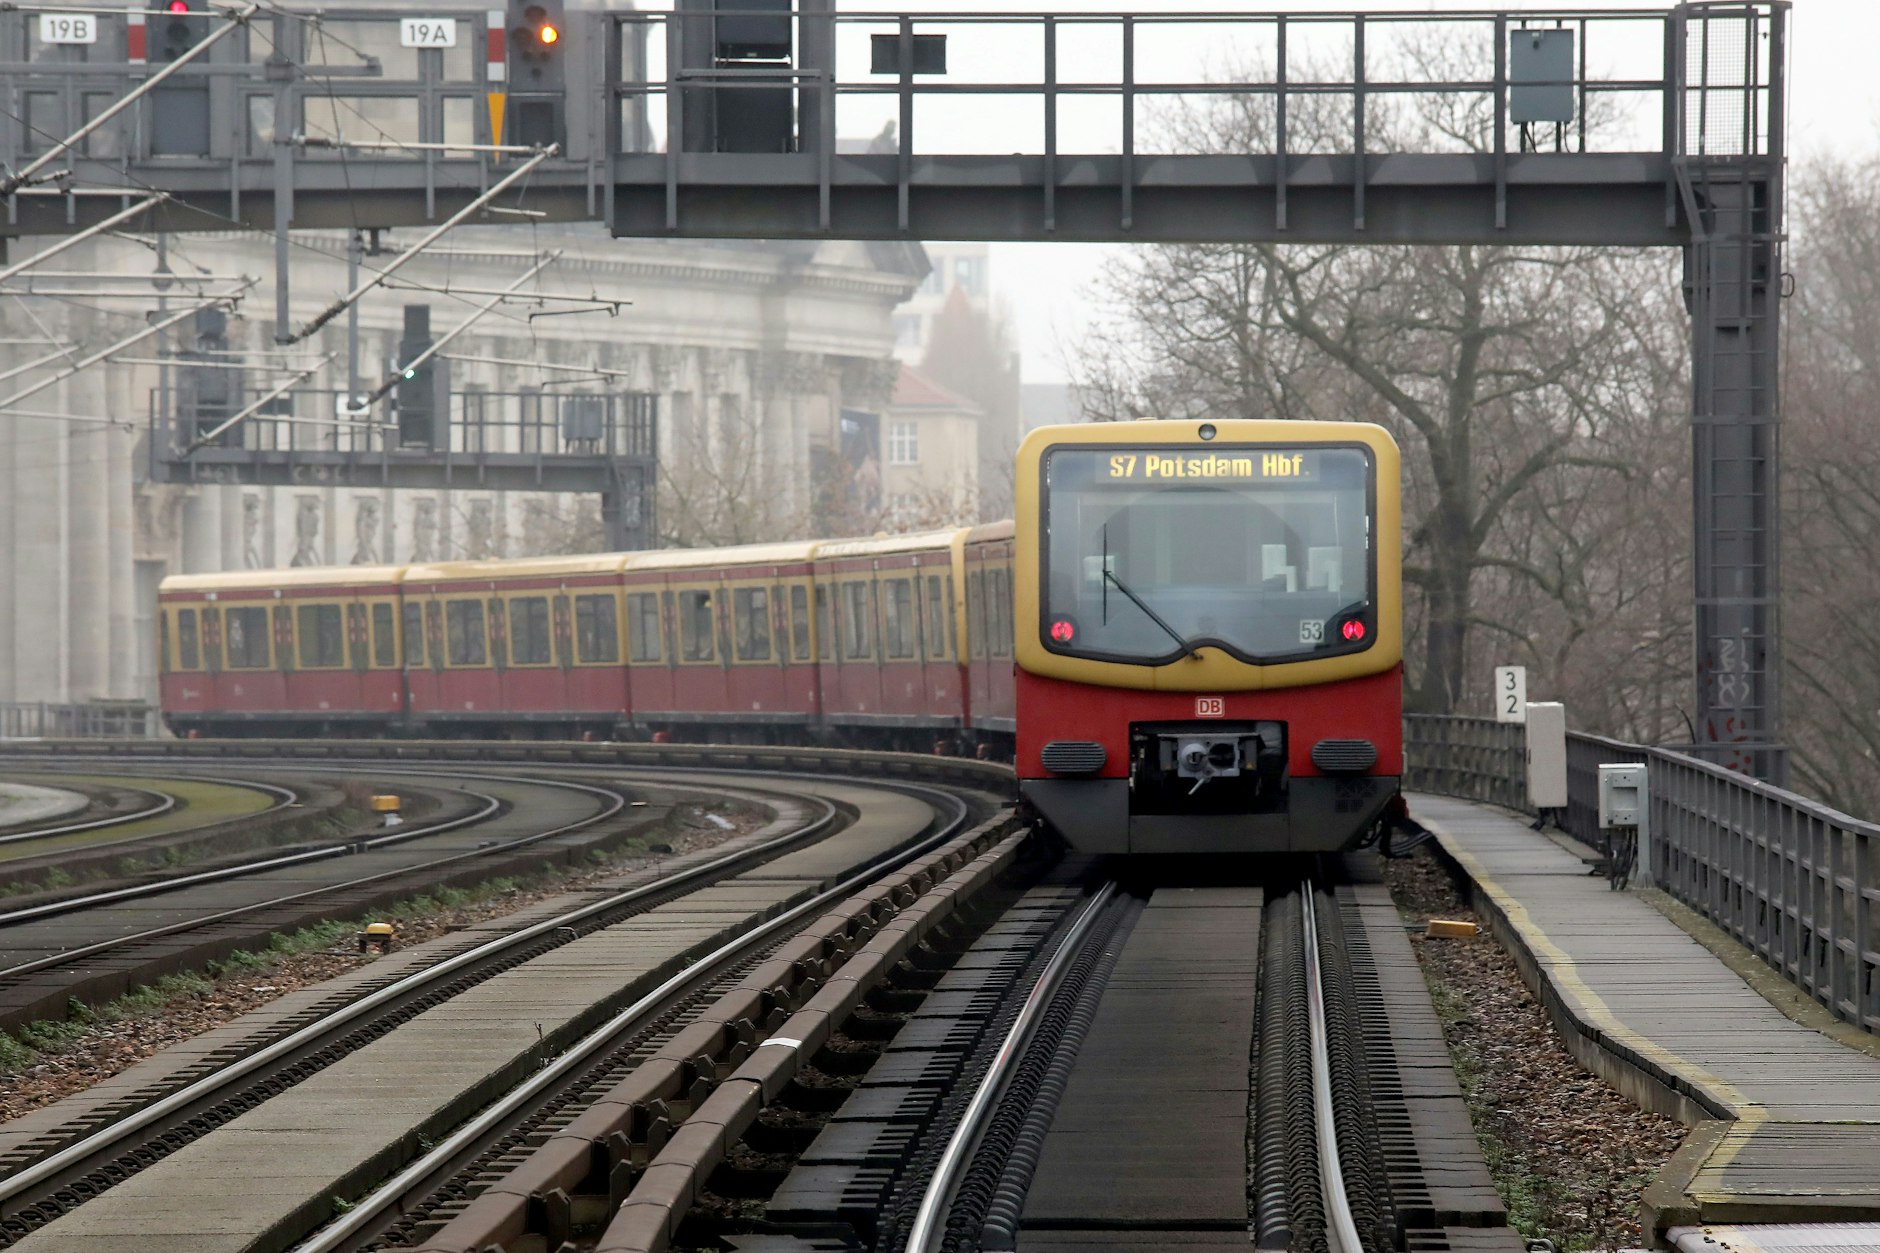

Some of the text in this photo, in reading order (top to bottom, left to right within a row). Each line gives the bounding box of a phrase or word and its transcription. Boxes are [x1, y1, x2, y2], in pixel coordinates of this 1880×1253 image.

[50, 20, 88, 39] 19B
[410, 24, 448, 43] 19A
[1109, 453, 1310, 478] S7 Potsdam Hbf.
[1301, 621, 1323, 641] 53
[1505, 671, 1517, 691] 3
[1198, 699, 1222, 714] DB
[1506, 694, 1519, 714] 2
